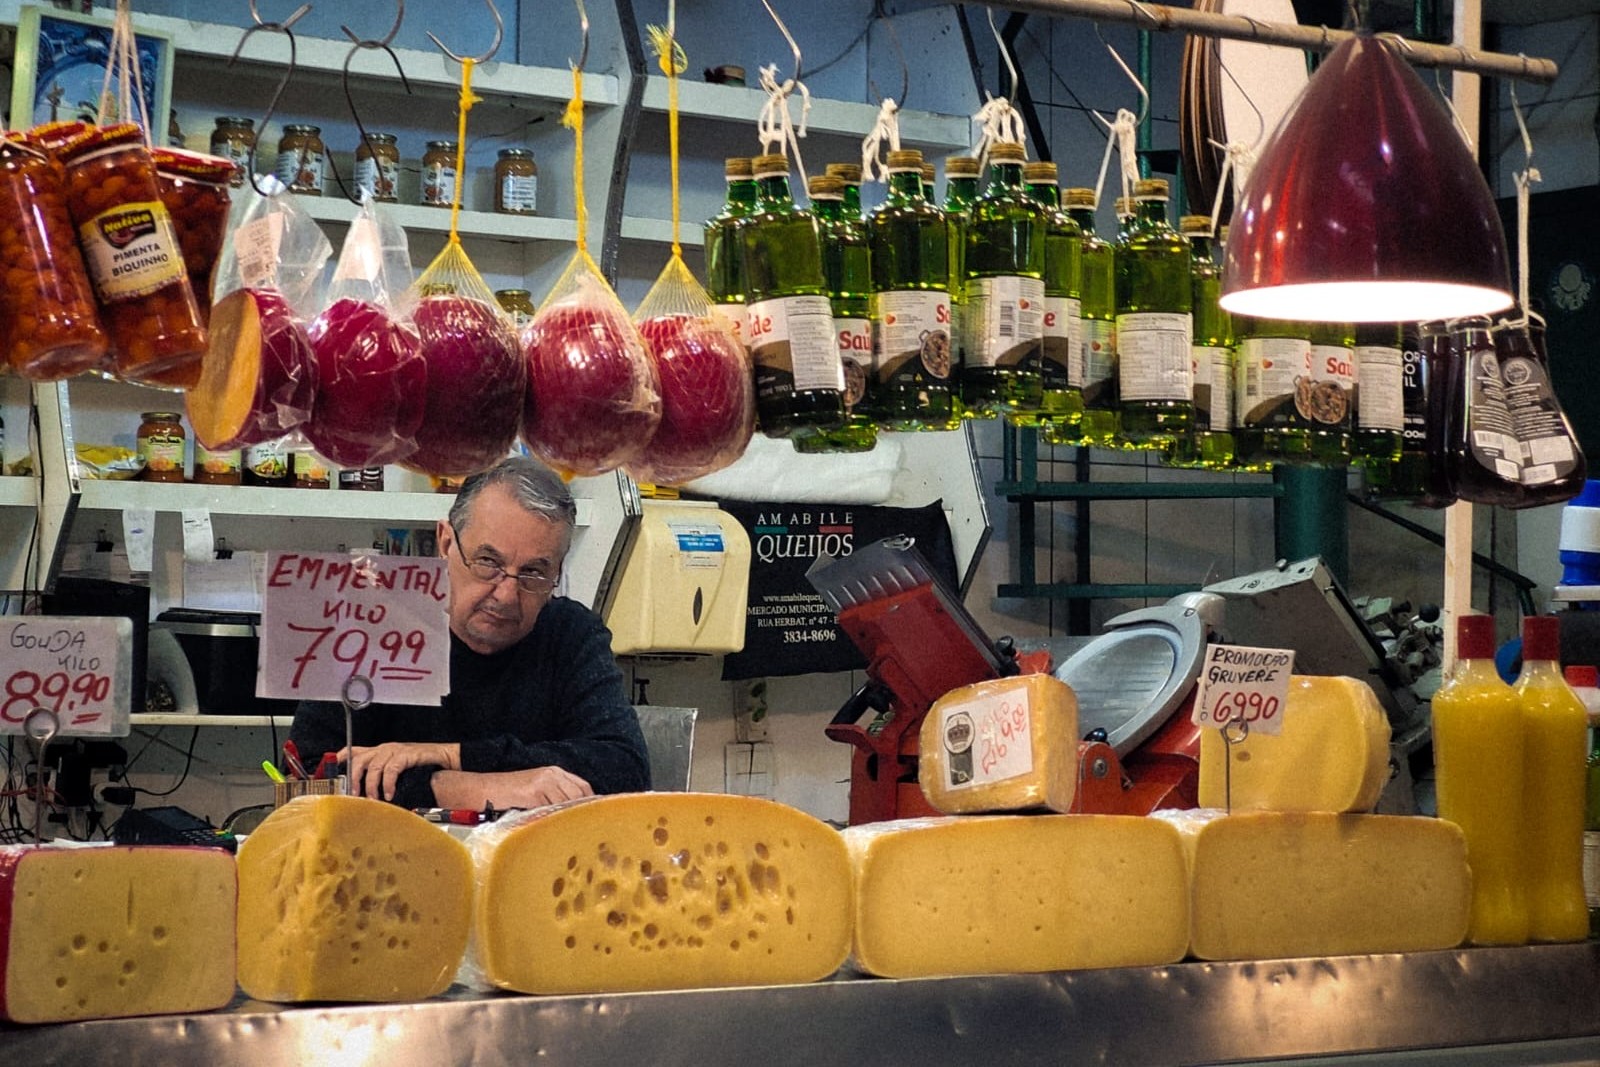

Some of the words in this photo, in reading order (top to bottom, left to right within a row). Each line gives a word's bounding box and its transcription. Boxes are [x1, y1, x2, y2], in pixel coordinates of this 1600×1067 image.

[113, 243, 161, 263] PIMENTA
[111, 253, 169, 277] BIQUINHO
[757, 512, 854, 526] AMABILE
[756, 534, 854, 564] QUEIJOS
[268, 554, 447, 602] EMMENTAL
[323, 599, 387, 628] KILO
[747, 605, 788, 616] MERCADO
[788, 604, 832, 615] MUNICIPA
[757, 618, 774, 628] RUA
[819, 616, 828, 625] 47
[10, 622, 86, 653] GOUDA
[783, 629, 837, 643] 3834-8696
[57, 655, 101, 671] KILO
[287, 622, 426, 689] 79,99
